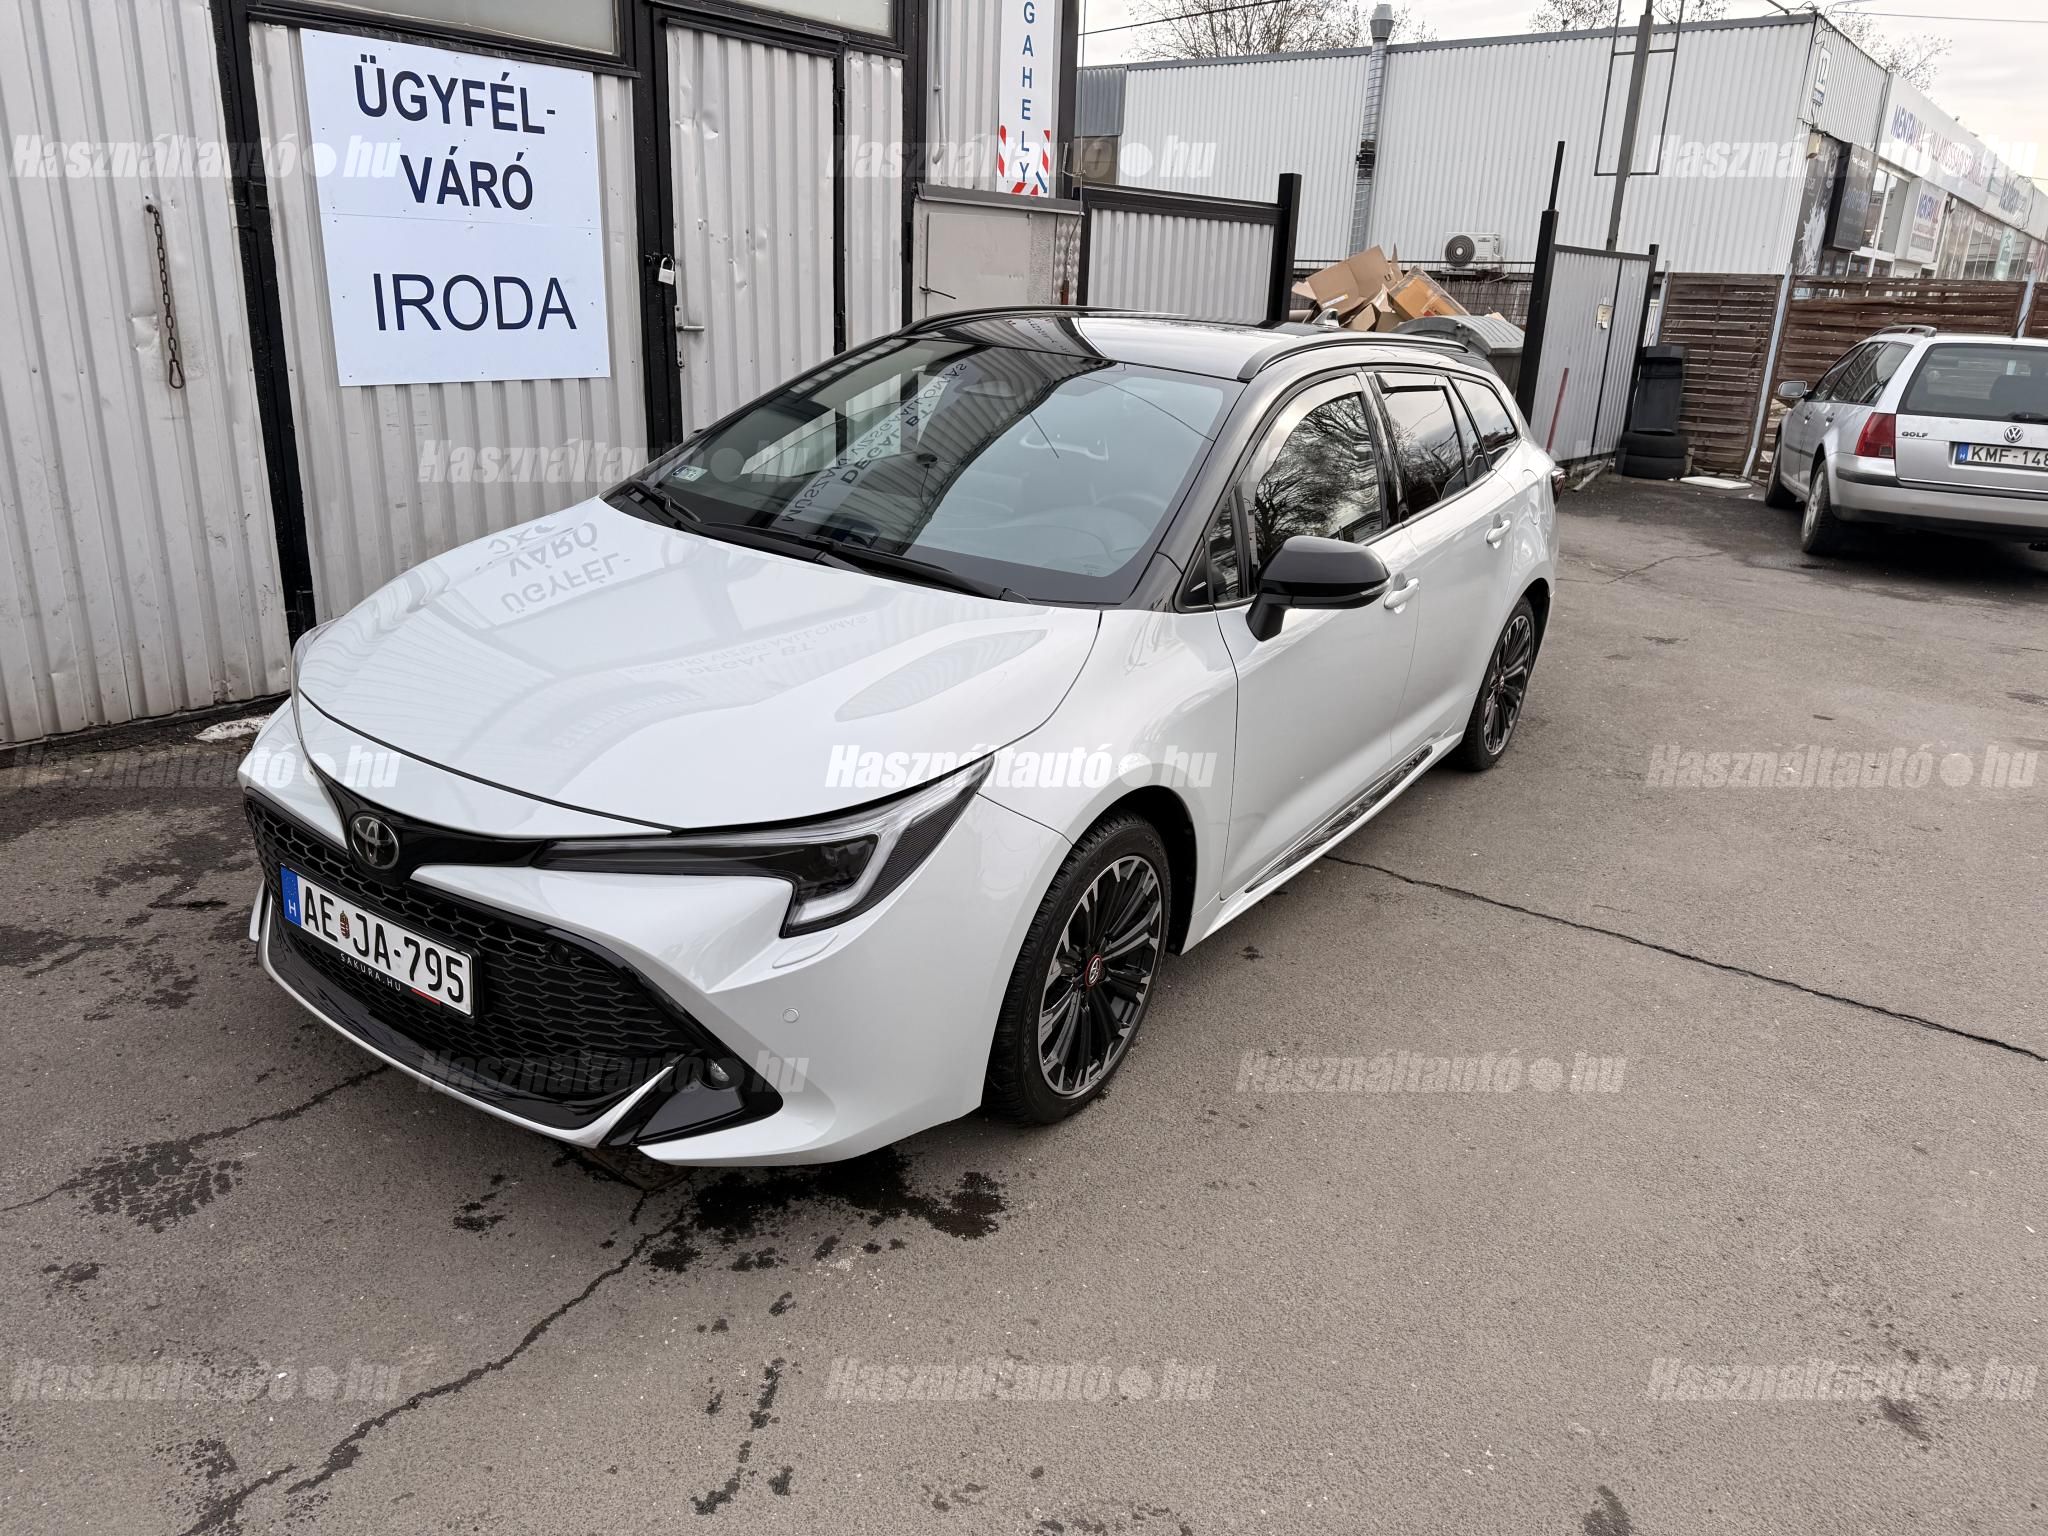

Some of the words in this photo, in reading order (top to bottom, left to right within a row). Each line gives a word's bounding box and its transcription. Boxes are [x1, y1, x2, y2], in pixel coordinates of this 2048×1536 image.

[354, 54, 556, 134] ÜGYFÉL-
[400, 145, 533, 211] VÁRÓ
[373, 273, 577, 331] IRODA
[304, 886, 338, 943] AE
[353, 912, 464, 1004] JA-795
[340, 953, 401, 992] SAKURA.HU
